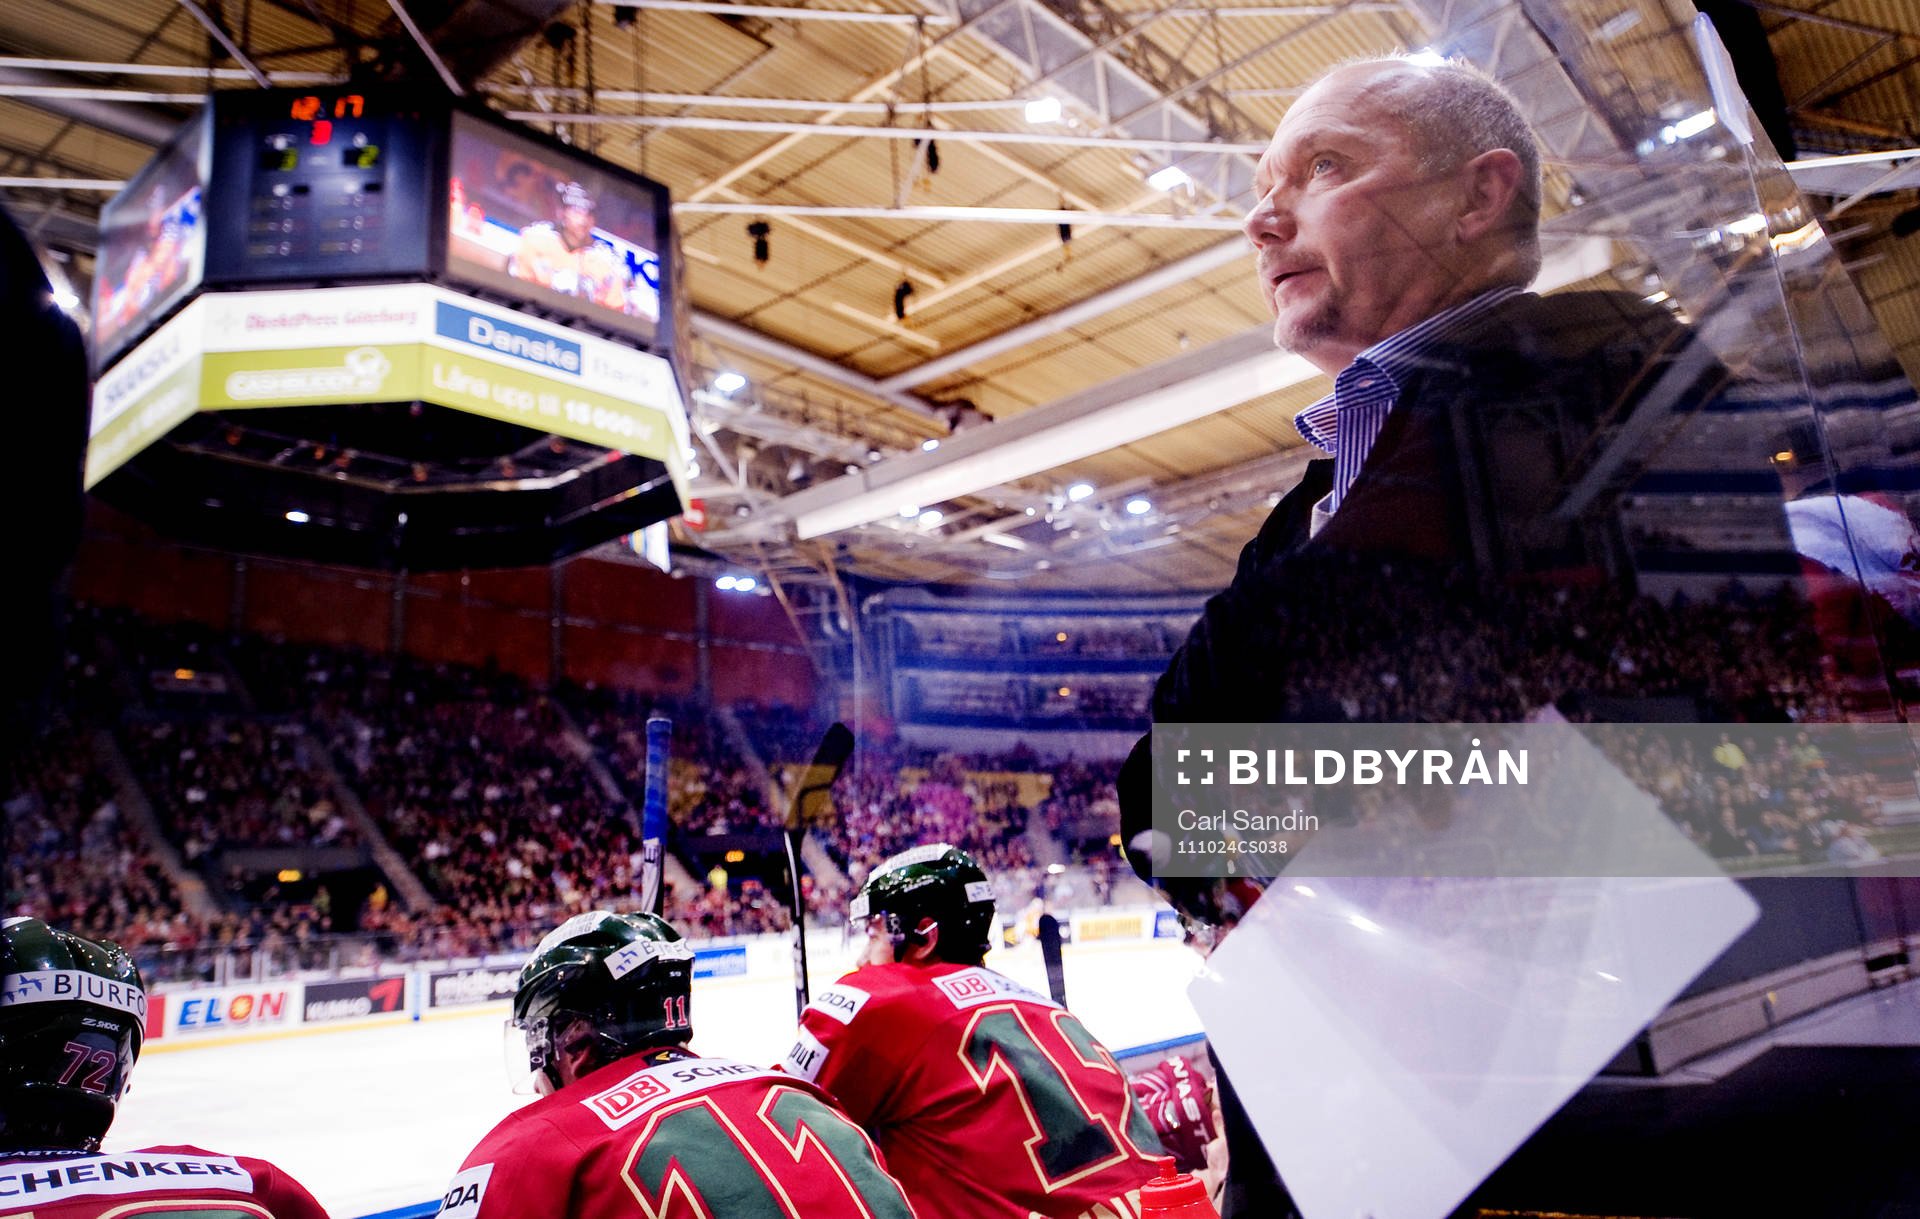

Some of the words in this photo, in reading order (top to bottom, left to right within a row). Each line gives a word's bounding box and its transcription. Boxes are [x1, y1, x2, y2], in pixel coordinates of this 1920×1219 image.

[467, 316, 579, 372] Danske
[950, 977, 988, 997] DB
[178, 991, 286, 1027] ELON
[664, 995, 688, 1029] 11
[58, 1041, 117, 1094] 72
[603, 1079, 659, 1113] DB
